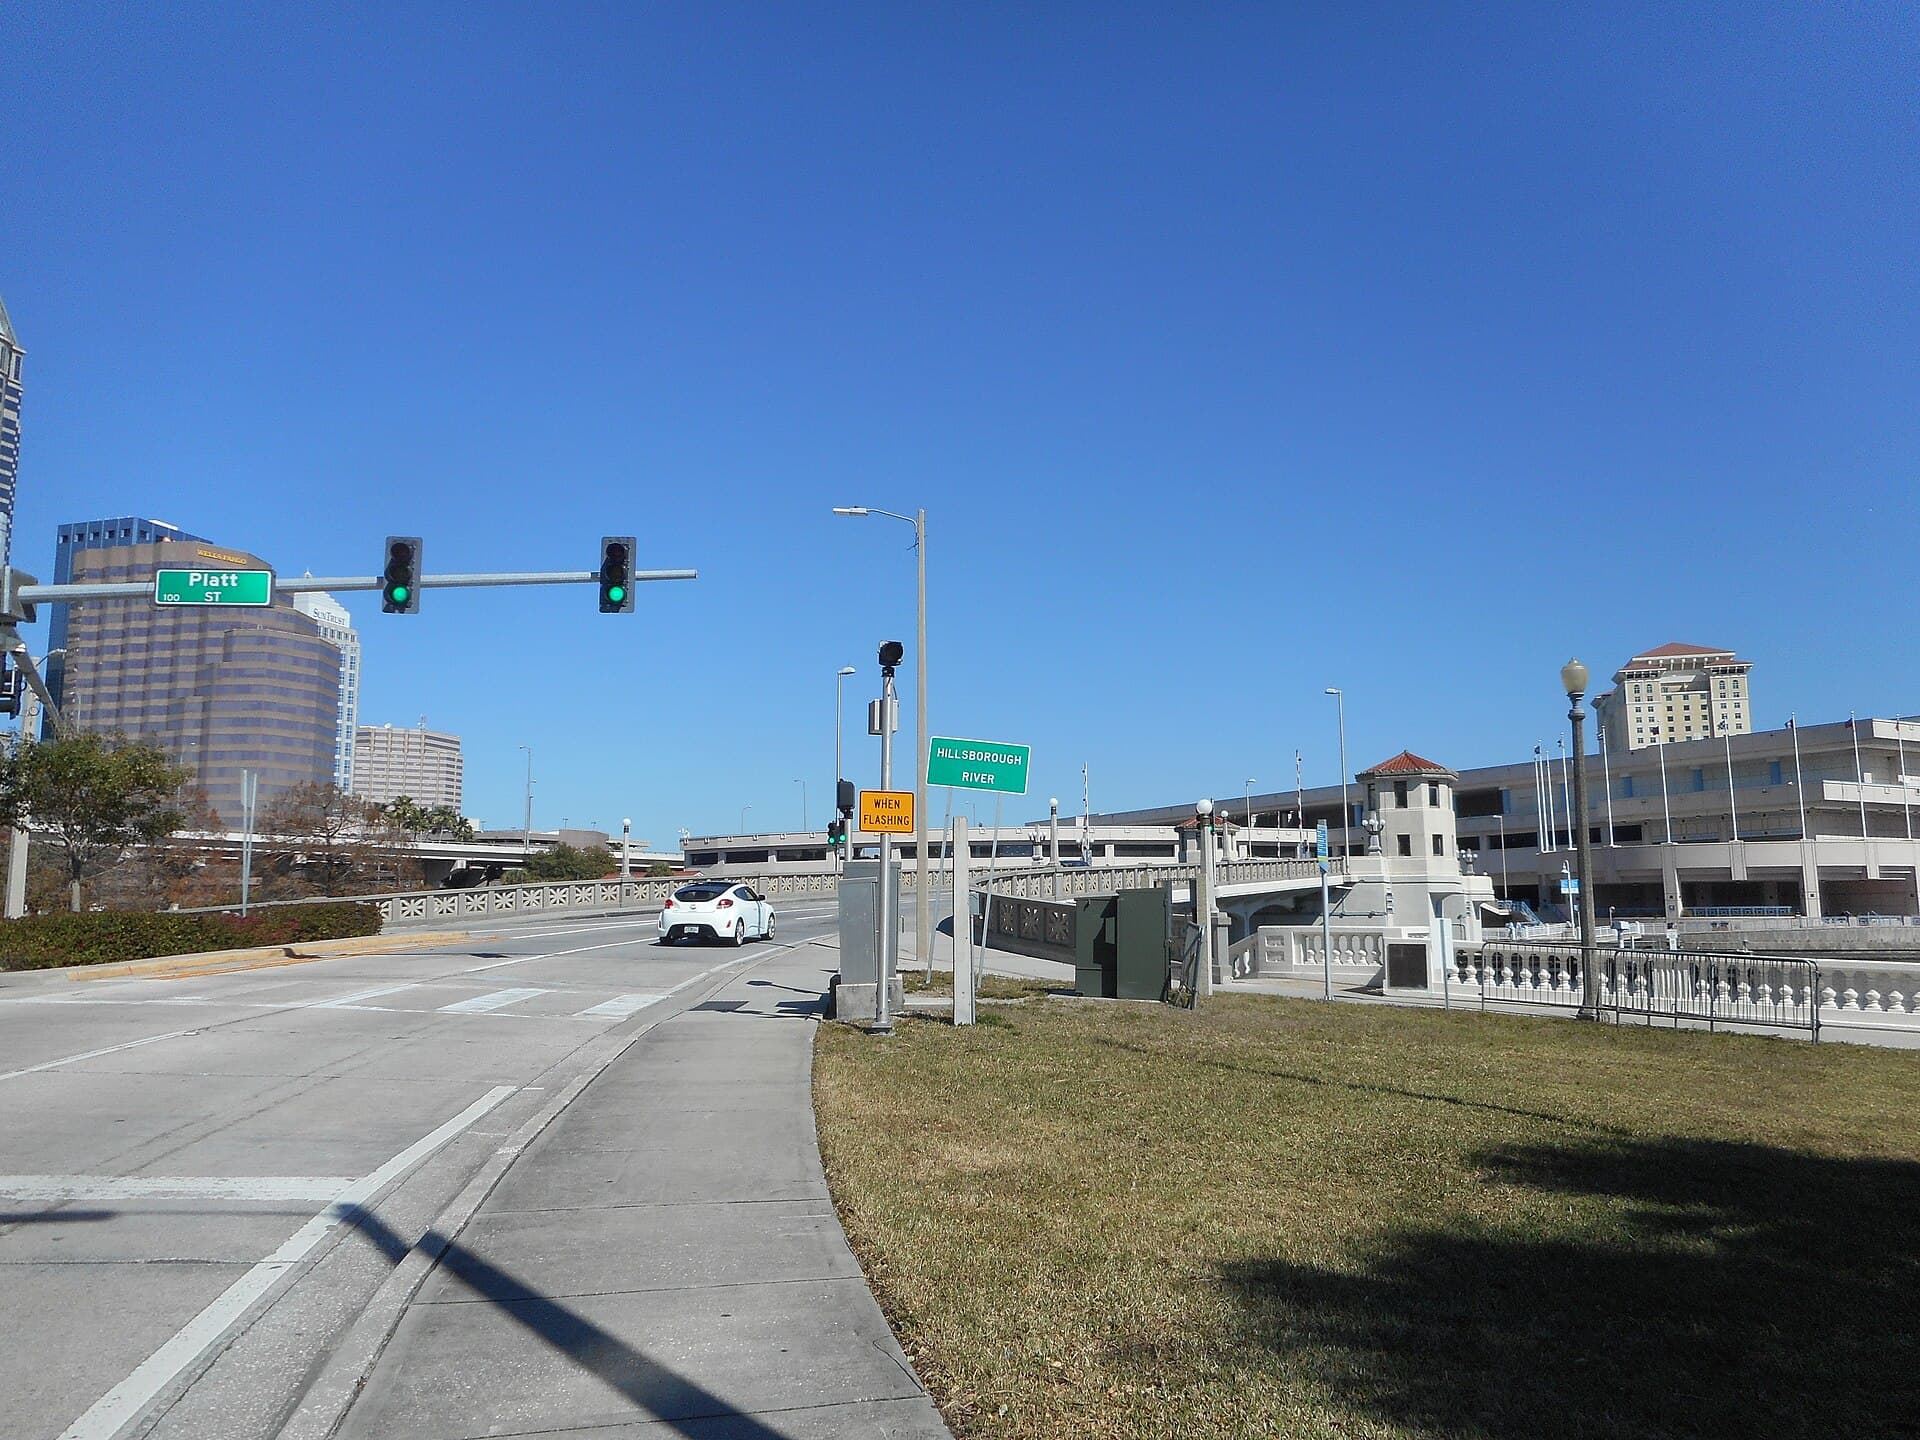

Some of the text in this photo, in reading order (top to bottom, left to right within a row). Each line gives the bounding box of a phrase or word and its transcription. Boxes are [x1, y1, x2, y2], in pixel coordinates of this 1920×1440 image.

[189, 573, 238, 587] Platt
[163, 594, 180, 602] 100
[204, 591, 222, 602] ST
[937, 747, 1022, 765] HILLSBOROUGH
[961, 771, 995, 784] RIVER
[874, 798, 901, 809] WHEN
[863, 814, 910, 826] FLASHING
